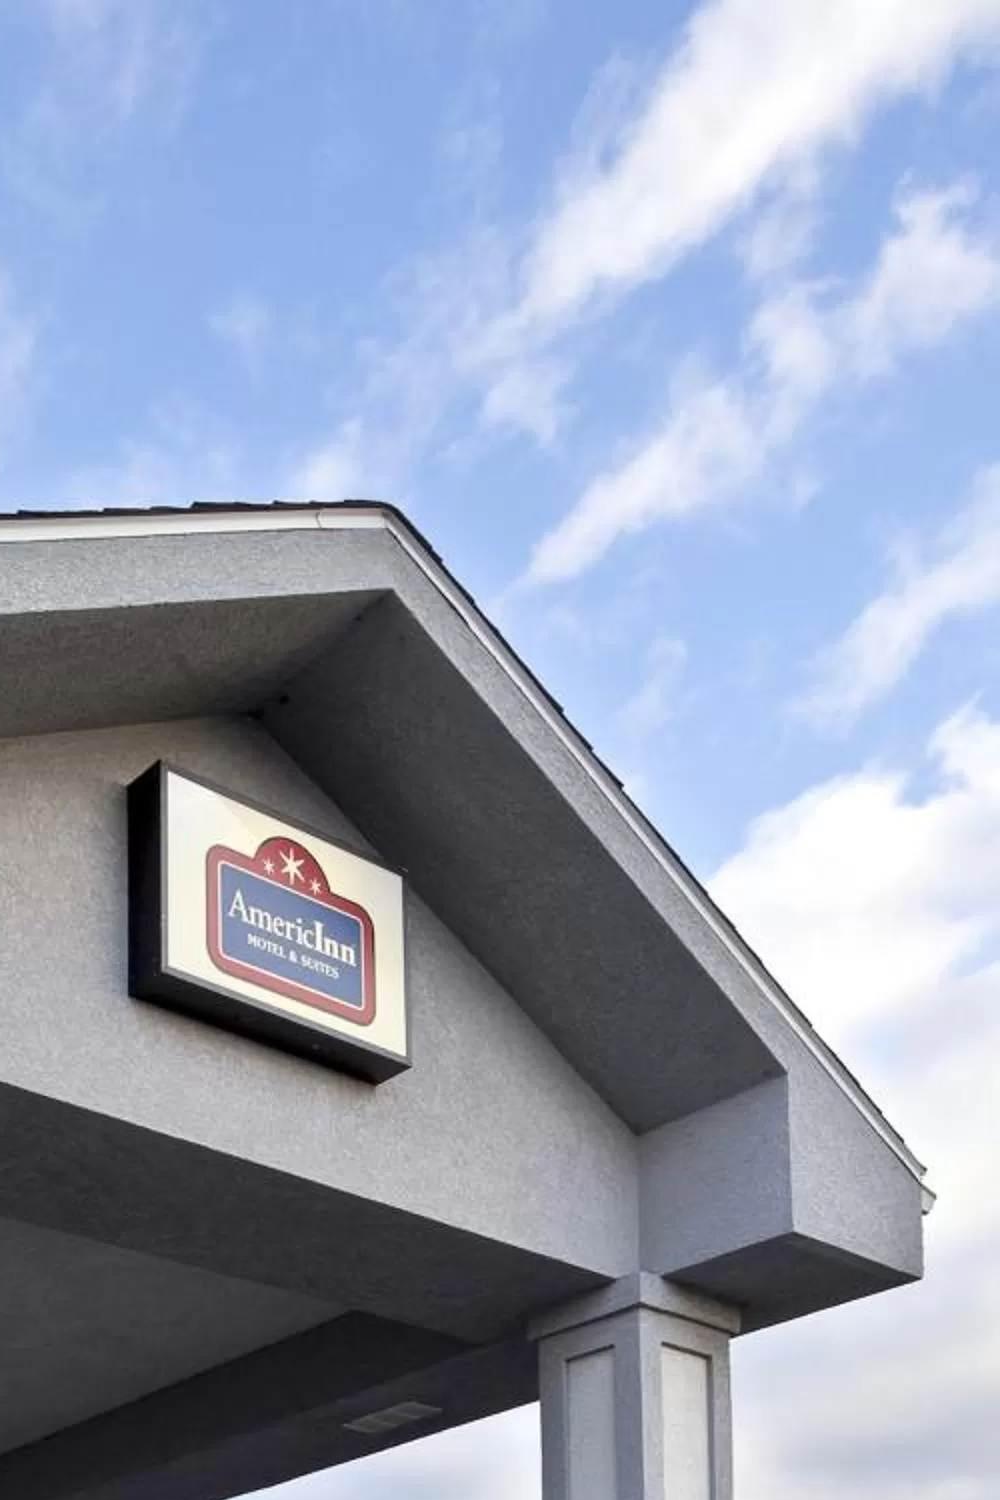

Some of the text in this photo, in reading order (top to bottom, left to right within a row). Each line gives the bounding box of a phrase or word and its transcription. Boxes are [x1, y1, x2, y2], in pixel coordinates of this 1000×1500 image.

[228, 888, 357, 967] AmericInn
[288, 950, 298, 963] &
[301, 955, 340, 980] SUITES
